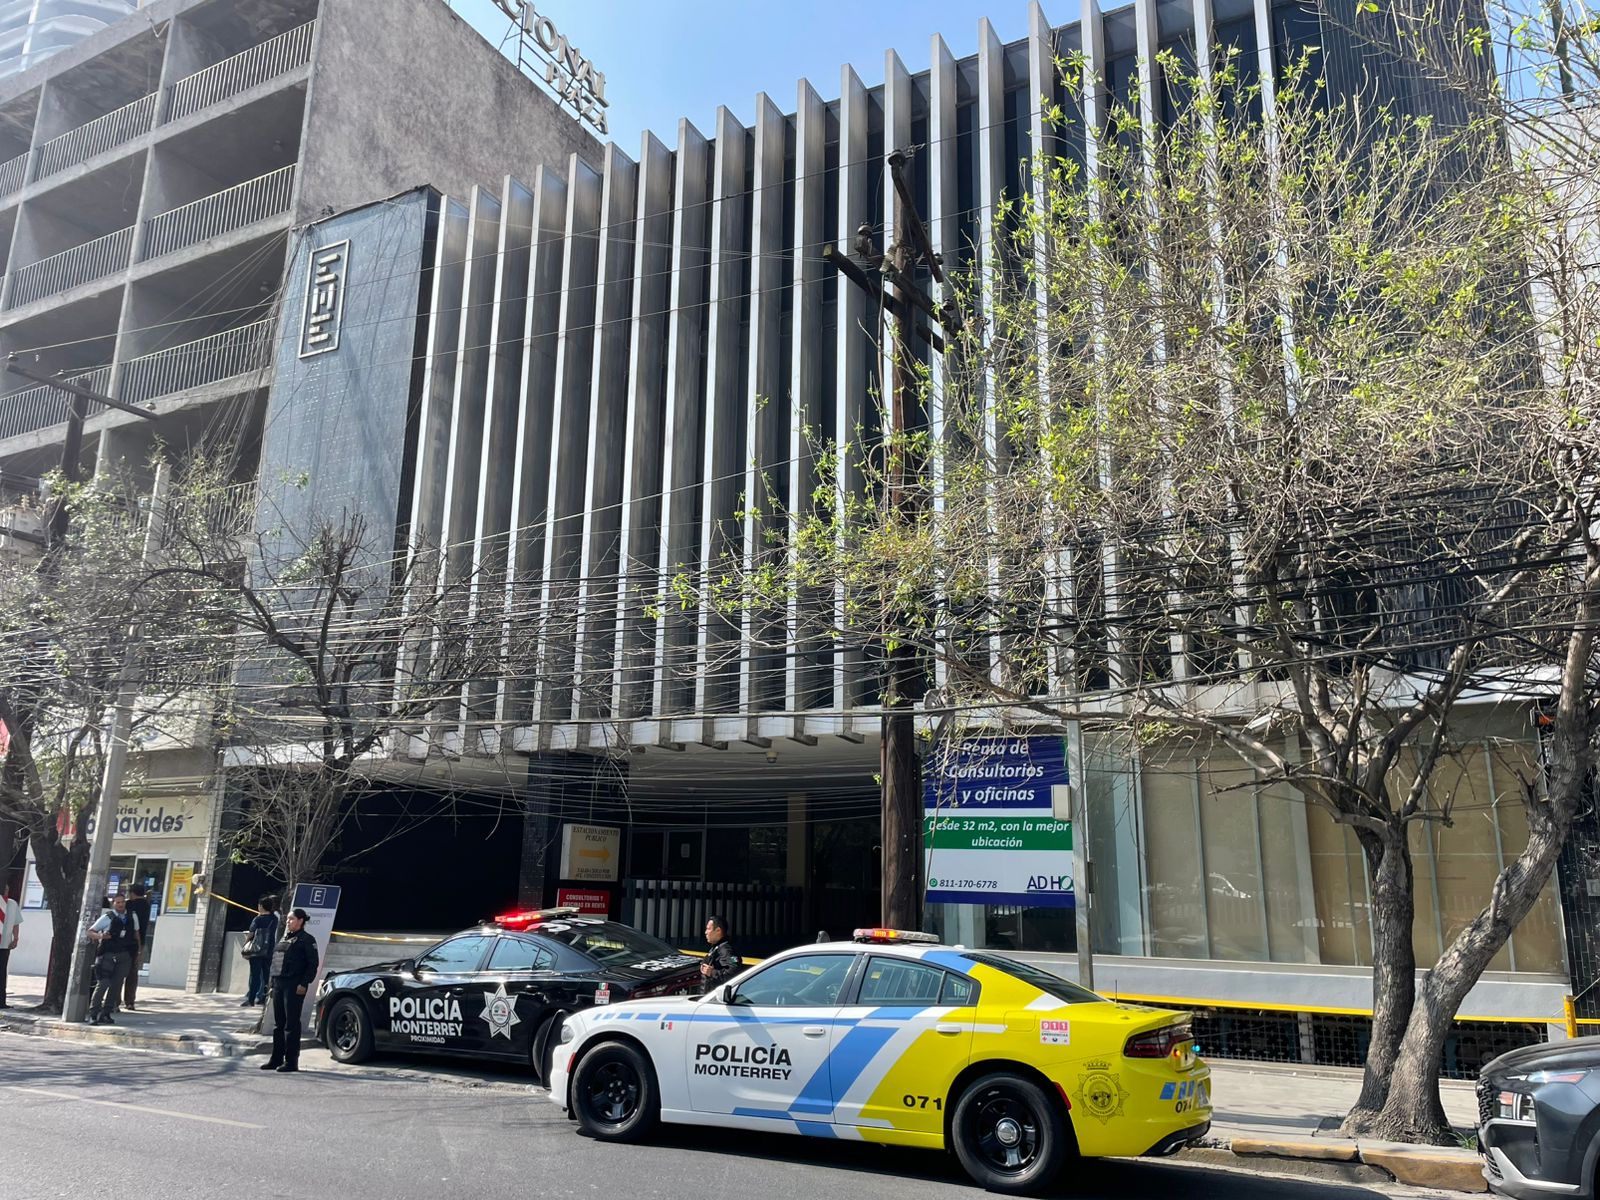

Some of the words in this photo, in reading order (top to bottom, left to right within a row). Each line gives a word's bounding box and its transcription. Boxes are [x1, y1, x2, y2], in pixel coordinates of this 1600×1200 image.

[491, 0, 609, 108] CIONAL
[962, 742, 1006, 755] Renta
[1010, 740, 1028, 755] de
[949, 763, 1044, 778] Consultorios
[962, 790, 971, 804] y
[975, 787, 1035, 803] oficinas
[929, 820, 960, 831] Desde
[962, 821, 975, 831] 32
[978, 821, 998, 833] m2,
[1001, 823, 1021, 832] con
[1023, 820, 1033, 831] la
[1036, 821, 1069, 834] mejor
[971, 836, 1023, 847] ubicación
[939, 879, 998, 889] 811-170-6778
[314, 890, 322, 901] E
[389, 991, 463, 1021] POLICÍA
[390, 1020, 463, 1037] MONTERREY
[1042, 1021, 1067, 1030] 911
[410, 1035, 446, 1044] PROXIMIDAD
[695, 1043, 792, 1066] POLICÍA
[694, 1064, 792, 1080] MONTERREY
[903, 1095, 942, 1110] 071
